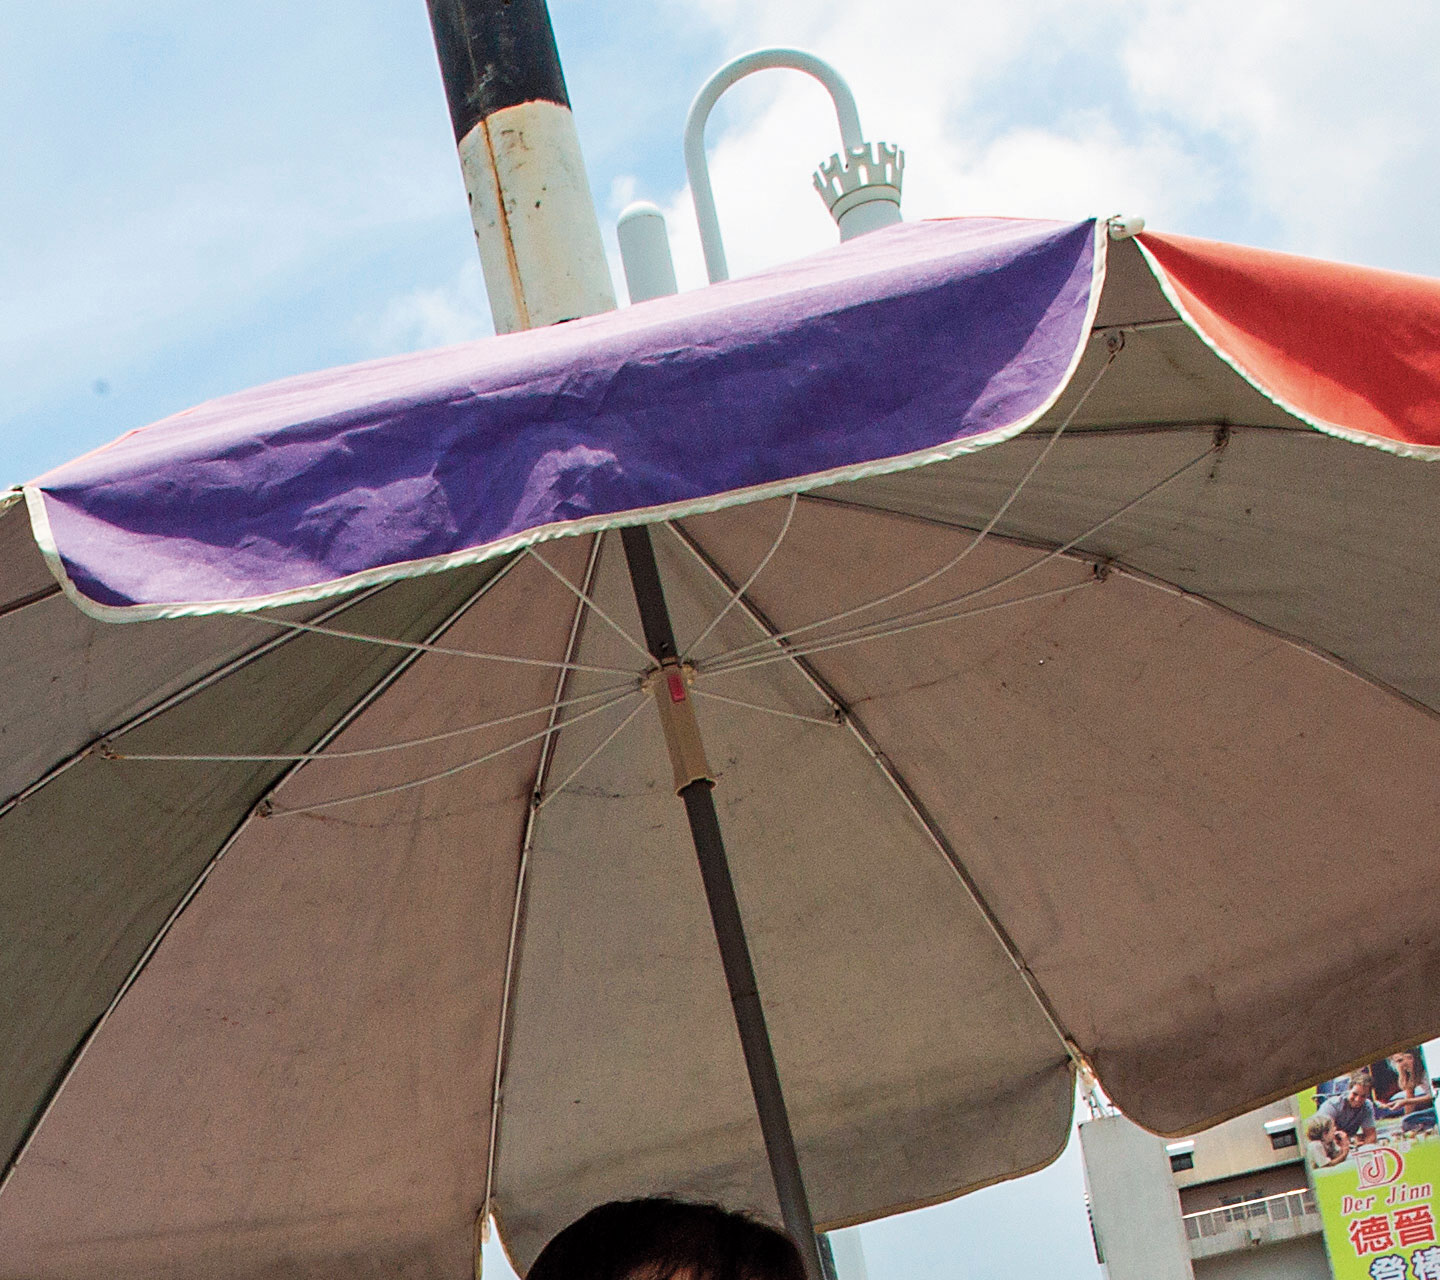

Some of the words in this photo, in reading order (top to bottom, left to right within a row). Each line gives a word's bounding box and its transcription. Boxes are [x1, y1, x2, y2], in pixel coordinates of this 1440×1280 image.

[1342, 1194, 1376, 1216] Der
[1385, 1183, 1432, 1205] Jinn
[1348, 1204, 1436, 1256] 德晉
